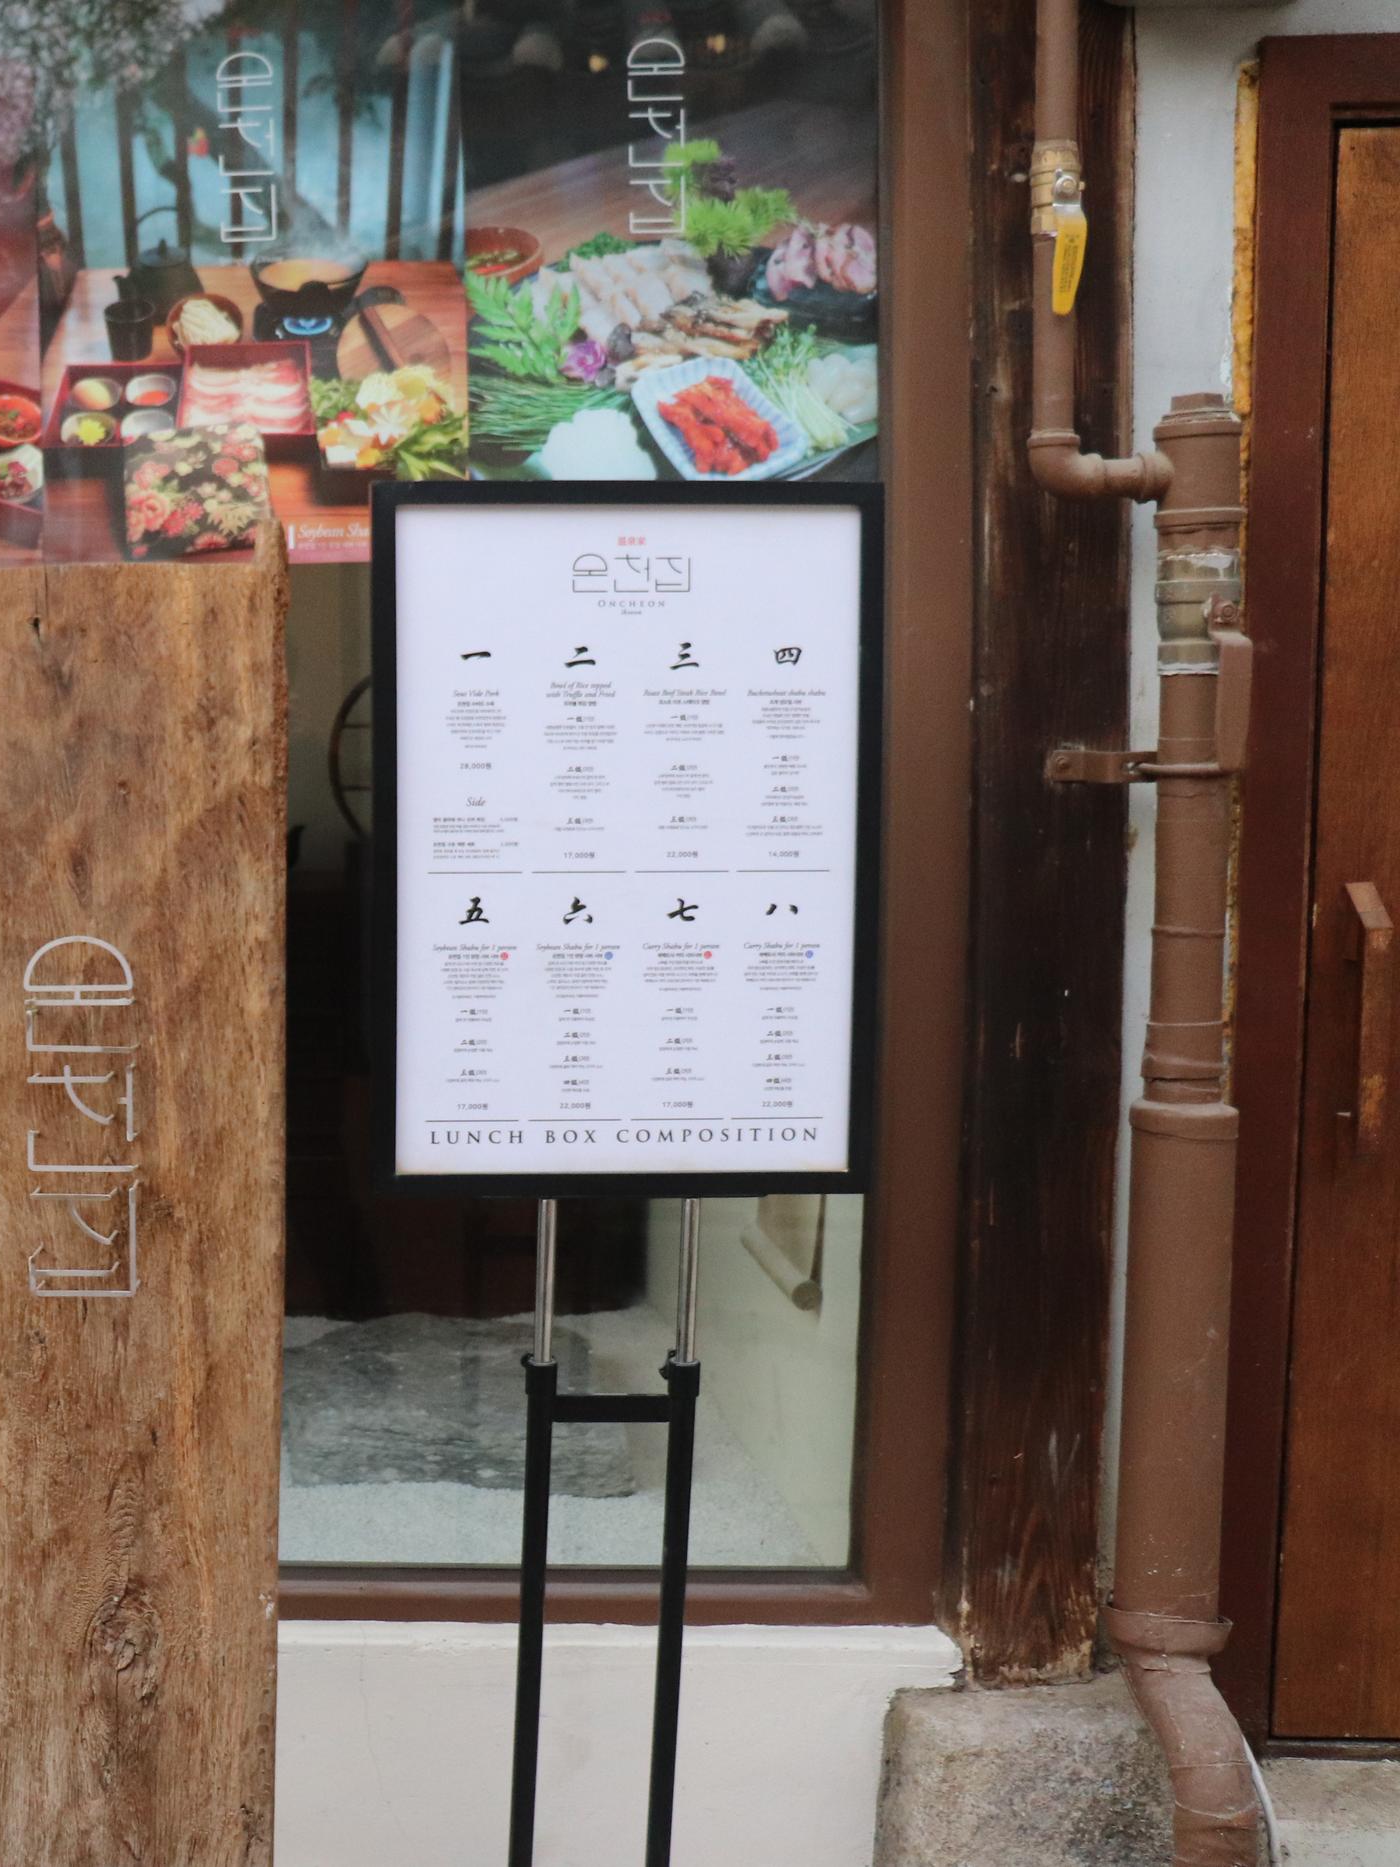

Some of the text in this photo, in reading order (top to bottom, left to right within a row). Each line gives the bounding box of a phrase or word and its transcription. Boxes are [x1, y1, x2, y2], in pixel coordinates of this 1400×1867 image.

[216, 52, 277, 243] 온천집
[627, 37, 685, 234] 온천집
[573, 553, 691, 593] 온천집
[460, 651, 491, 660] 一
[564, 646, 596, 668] 二
[669, 642, 699, 670] 三
[773, 646, 802, 666] 四
[466, 796, 486, 807] Side
[459, 896, 490, 925] 五
[563, 896, 593, 925] 六
[667, 897, 699, 921] 七
[765, 903, 799, 916] 八
[23, 935, 141, 1297] 온천집
[431, 1127, 819, 1145] LUNCH BOX COMPOSITION
